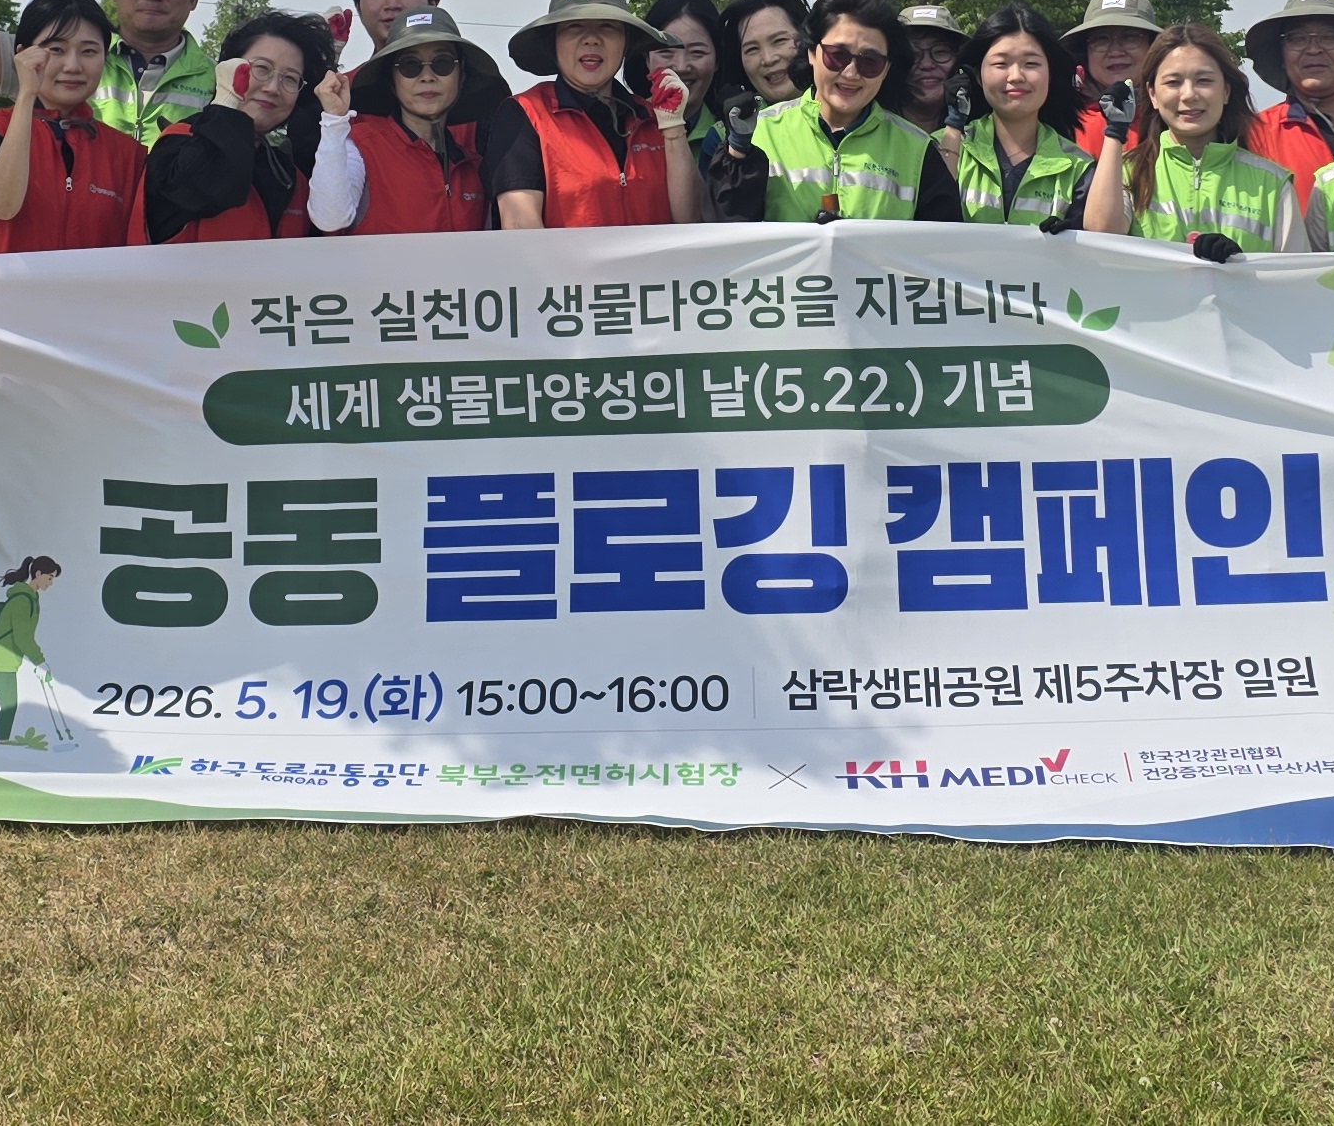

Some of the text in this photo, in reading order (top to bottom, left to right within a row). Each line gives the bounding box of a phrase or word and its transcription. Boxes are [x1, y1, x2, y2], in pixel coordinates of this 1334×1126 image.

[250, 273, 1048, 347] 작은 실천이 생물다양성을 지킵니다
[285, 360, 1034, 431] 세계 생물다양성의 날(5.22.) 기념
[99, 452, 1329, 628] 공동 플로깅 캠페인
[92, 656, 1320, 724] 2026. 5. 19.(화) 15:00~16:00 삼락생태공원 제5주차장 일원
[1138, 745, 1283, 764] 한국건강관리협회
[190, 757, 743, 788] 한국도로교통공단 북부운전면허시험장
[260, 773, 332, 786] KOROAD
[834, 760, 930, 790] KH
[1142, 761, 1253, 781] 건강증진의원
